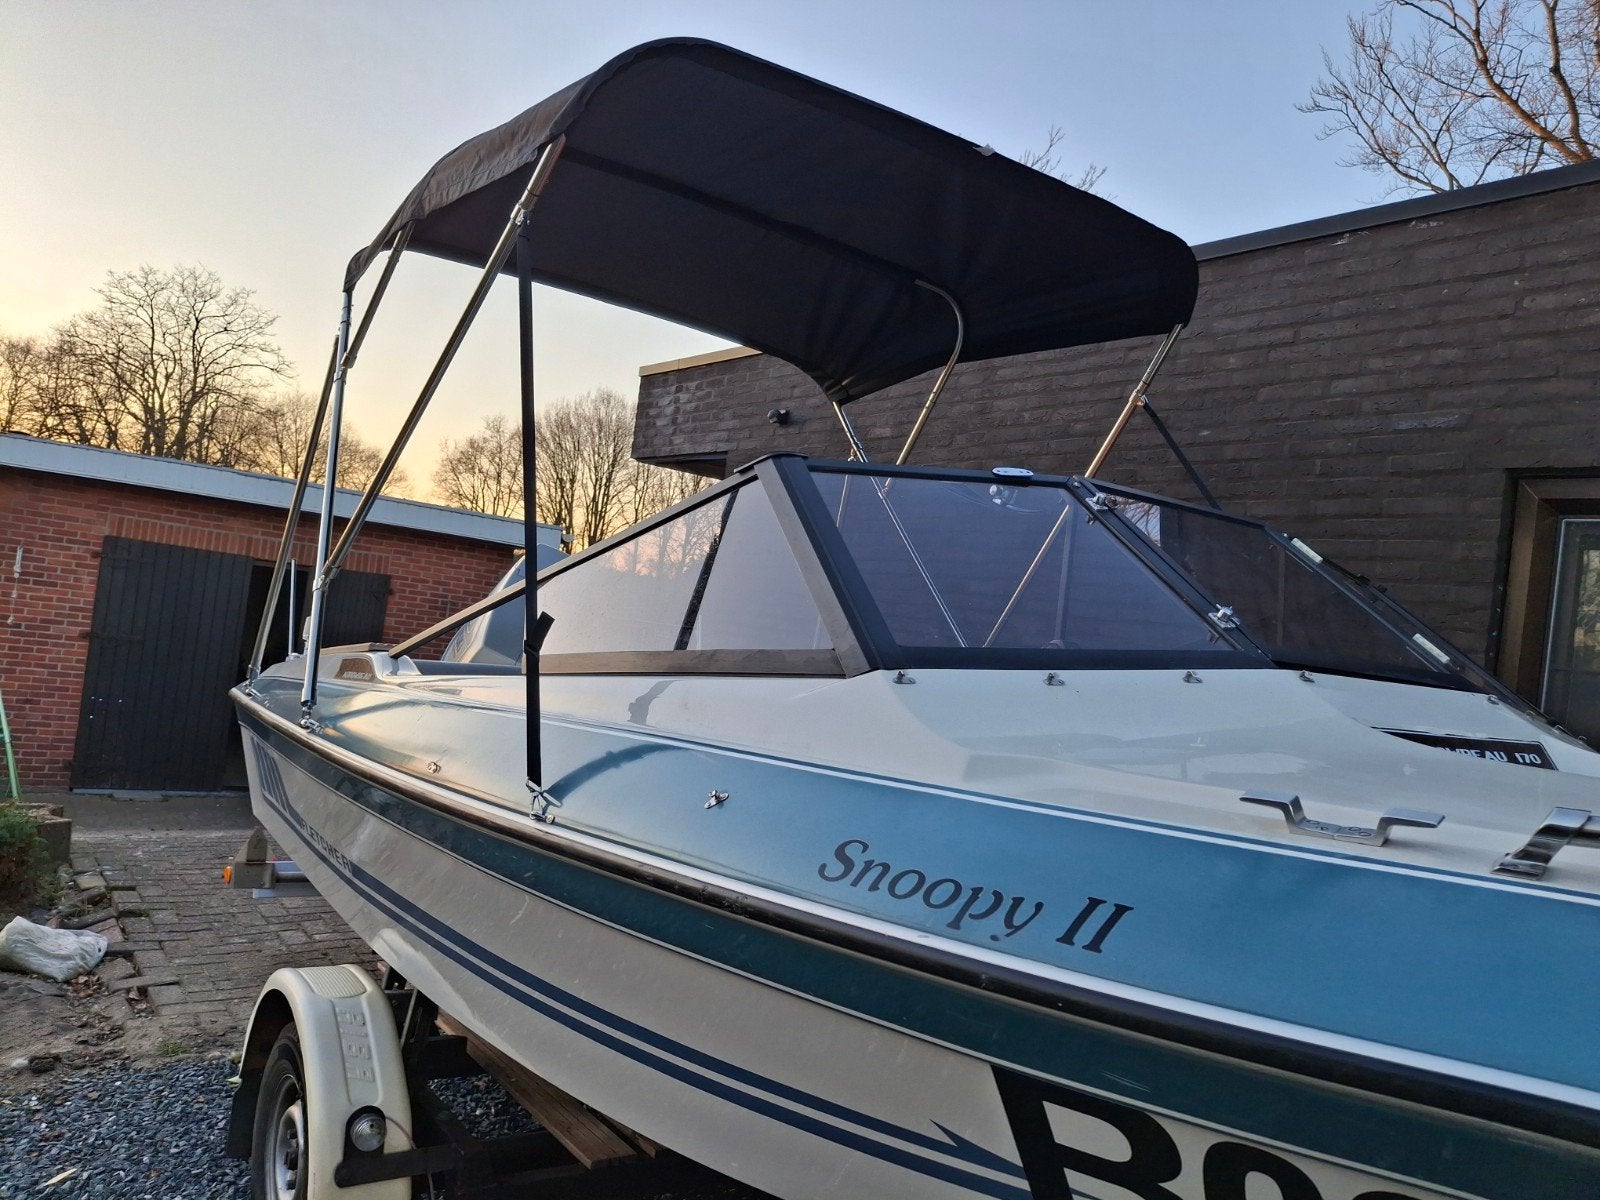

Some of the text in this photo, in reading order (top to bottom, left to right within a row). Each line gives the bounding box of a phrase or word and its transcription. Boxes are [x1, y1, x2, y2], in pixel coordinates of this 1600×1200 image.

[1514, 752, 1542, 764] 170
[301, 818, 352, 873] FLETCHER
[817, 839, 1135, 953] Snoopy II
